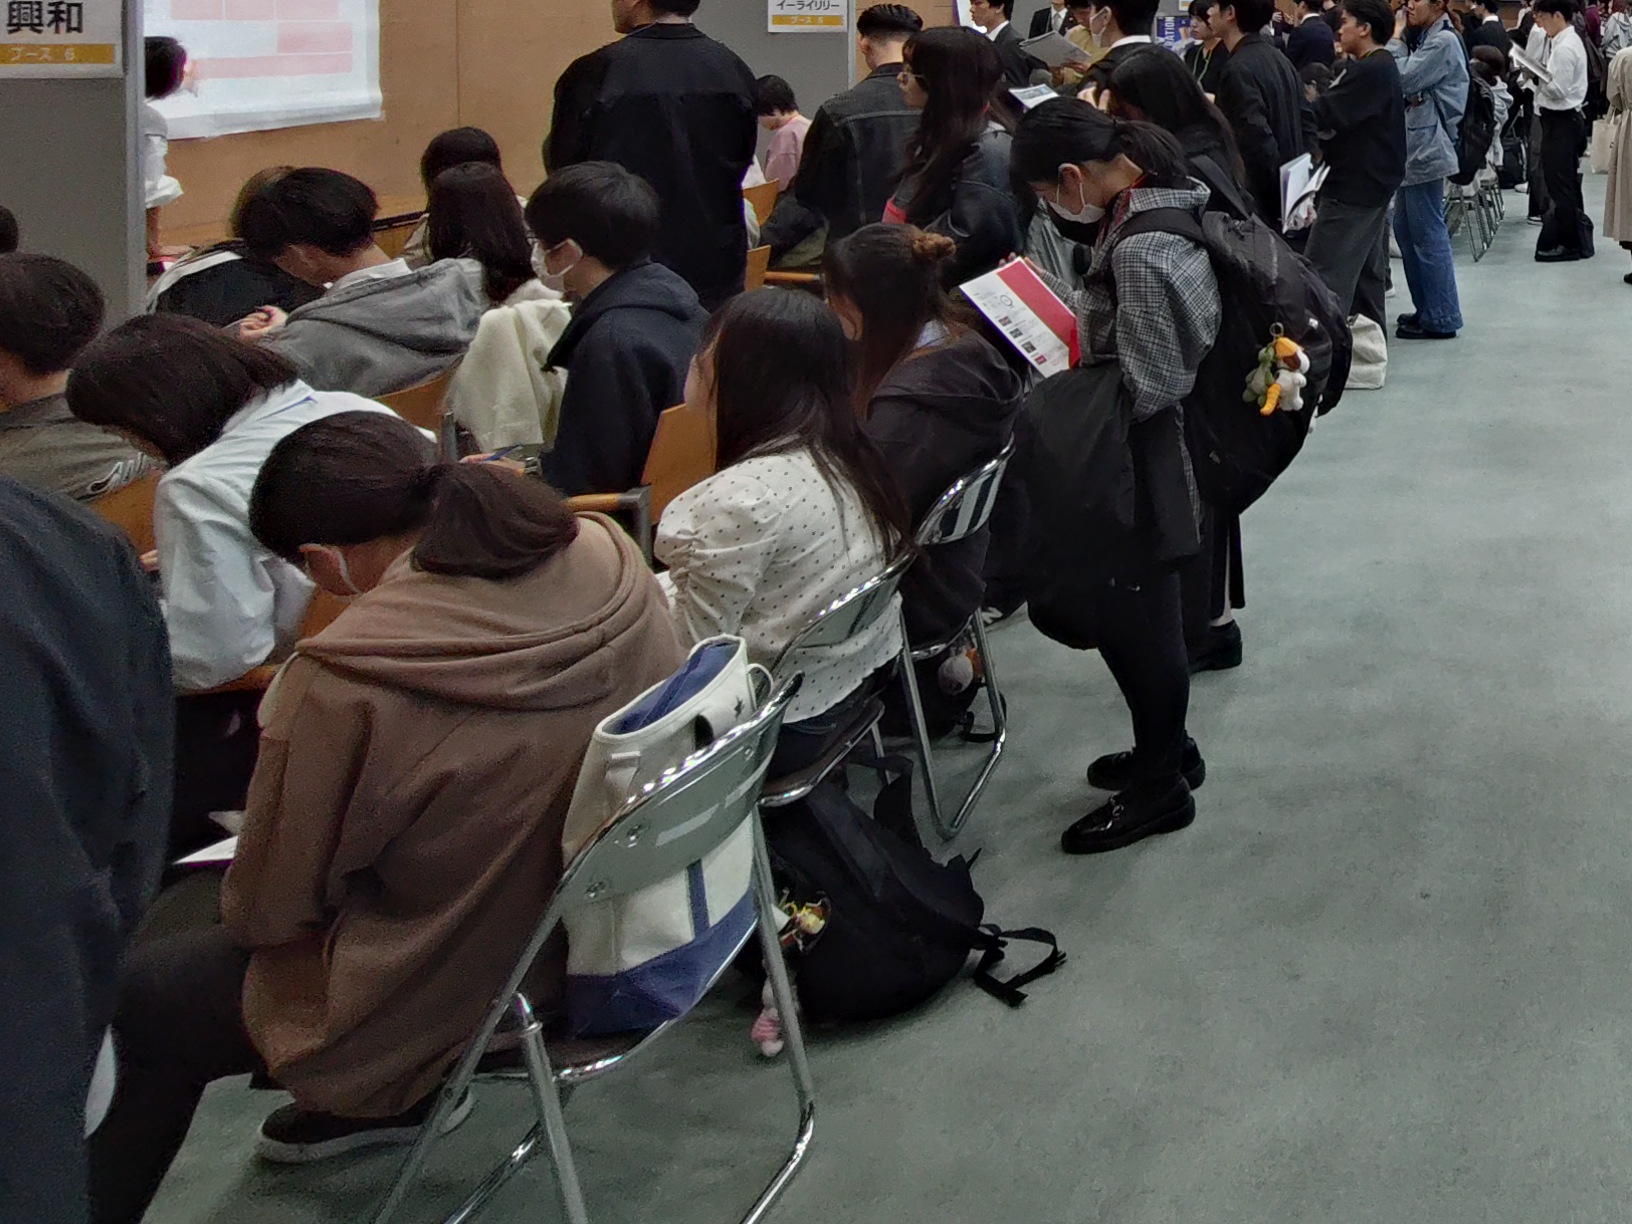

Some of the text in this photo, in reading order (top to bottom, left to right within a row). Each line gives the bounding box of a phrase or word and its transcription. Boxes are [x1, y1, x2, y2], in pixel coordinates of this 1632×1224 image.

[776, 0, 840, 11] イーライリリー
[6, 0, 84, 35] 興和
[11, 47, 52, 62] ブース
